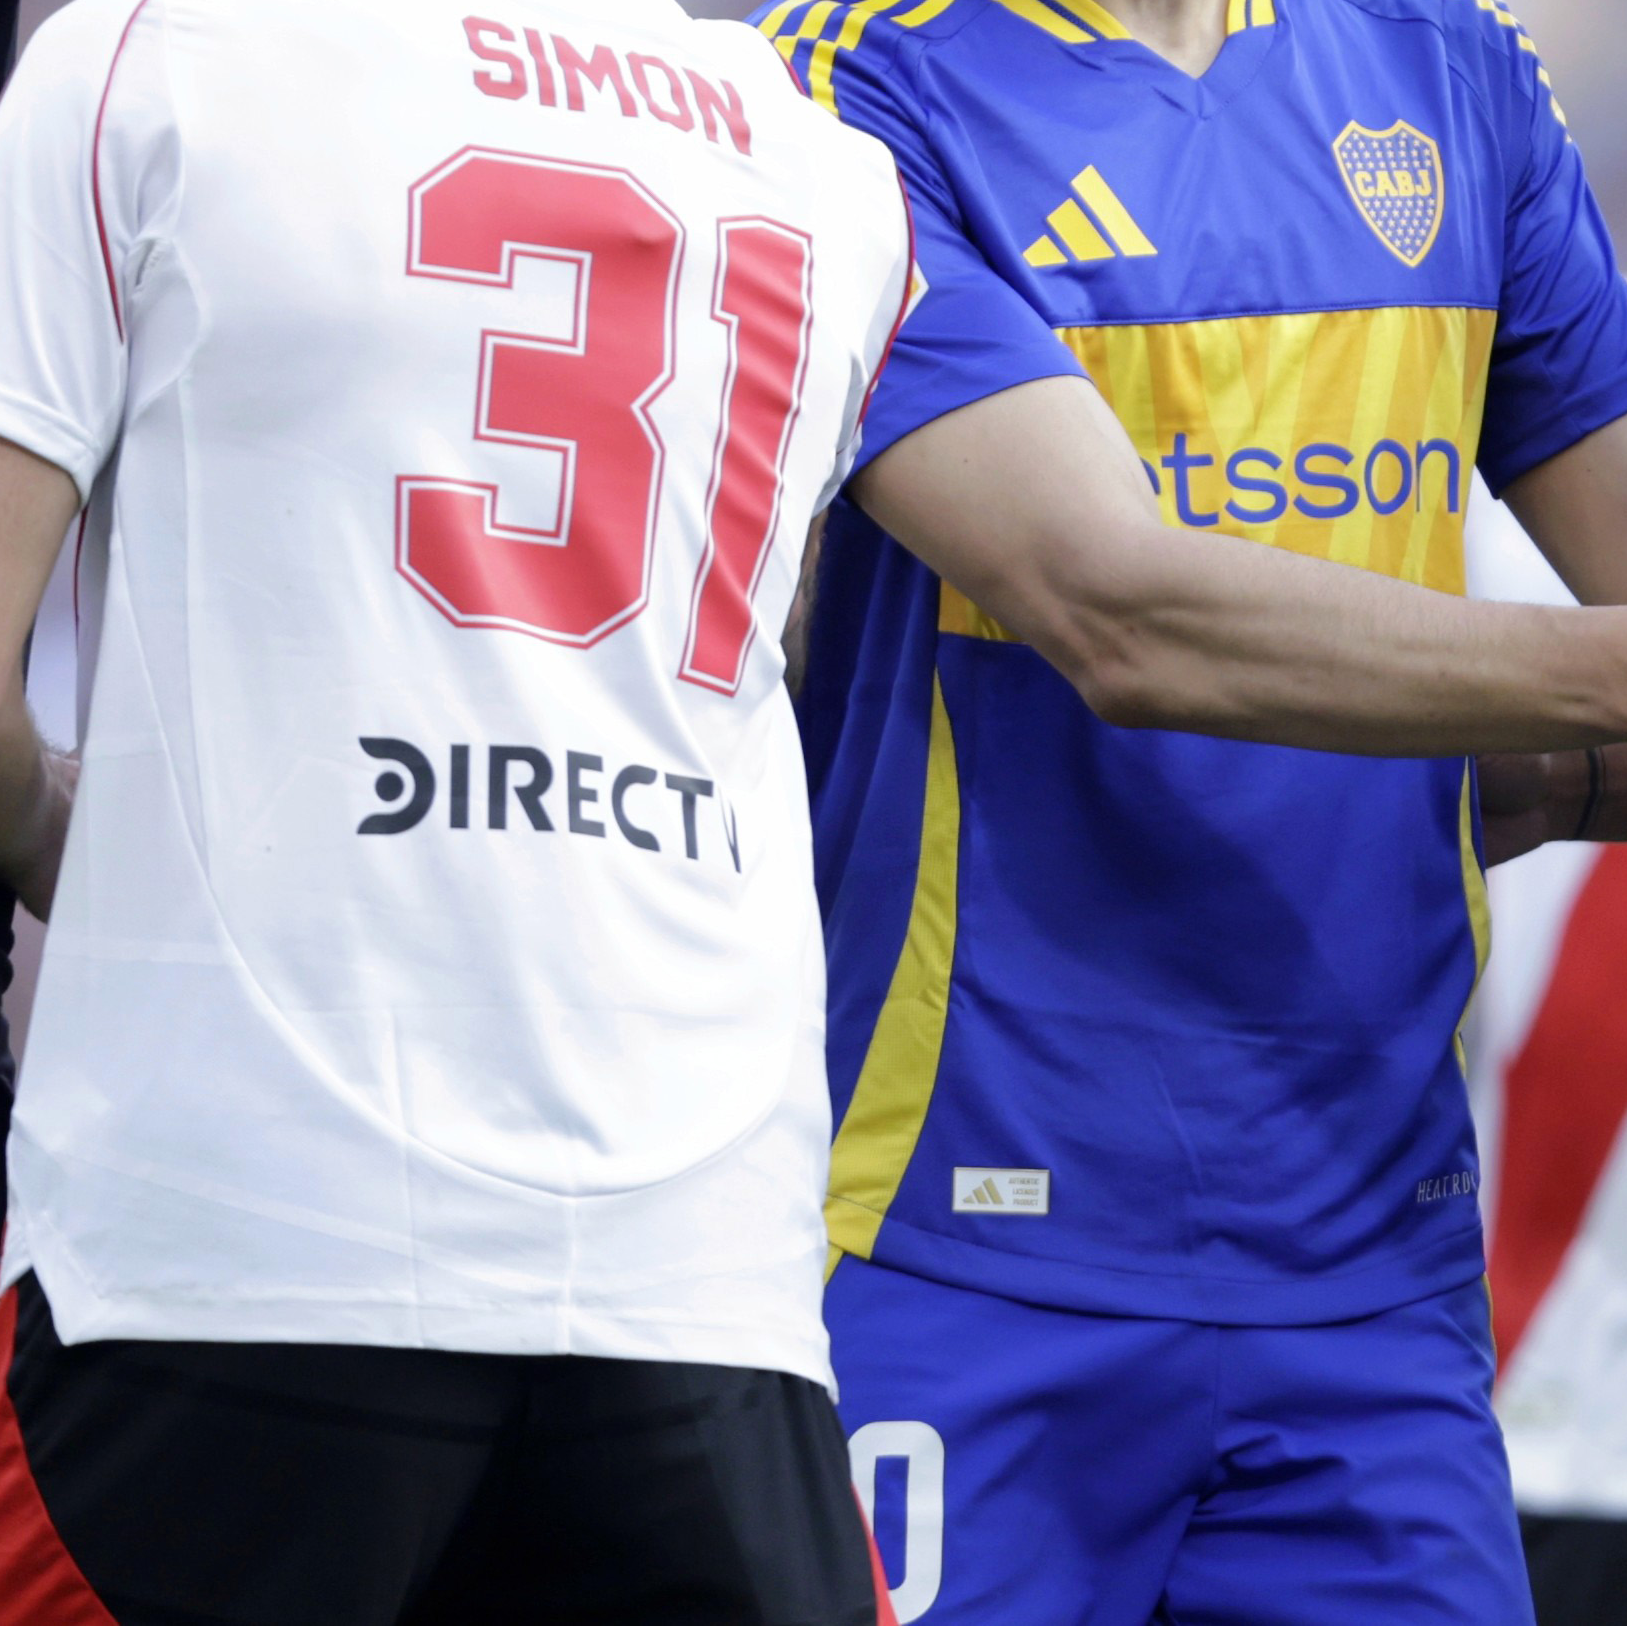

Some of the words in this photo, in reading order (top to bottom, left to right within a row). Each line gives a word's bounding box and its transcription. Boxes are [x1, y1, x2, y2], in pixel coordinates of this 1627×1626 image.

[462, 15, 752, 156] SIMON
[1354, 169, 1432, 198] CABJ
[395, 144, 812, 697] 31
[1140, 432, 1460, 527] tsson
